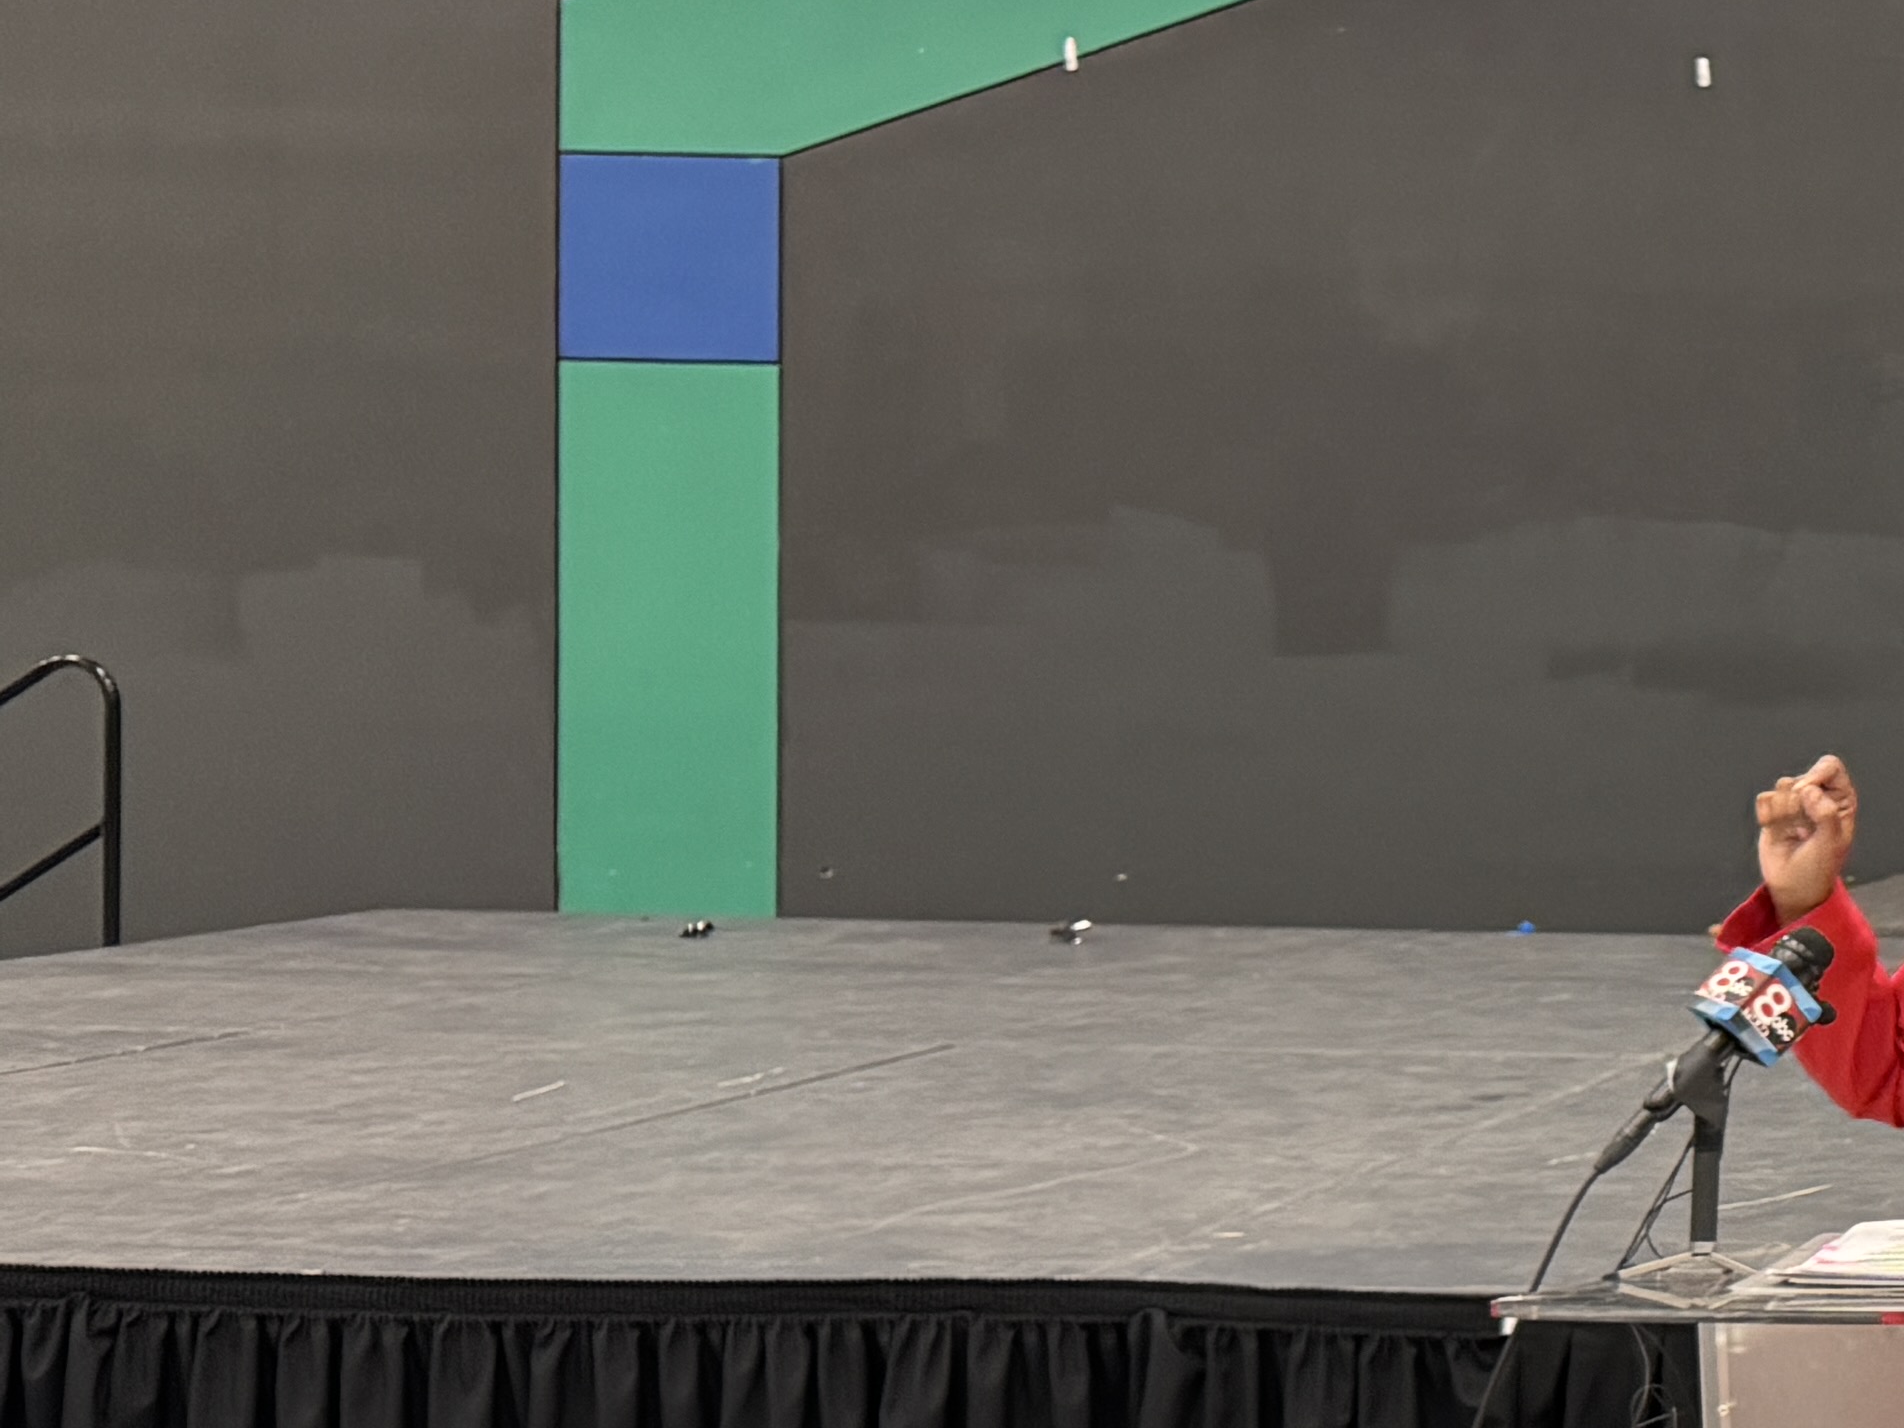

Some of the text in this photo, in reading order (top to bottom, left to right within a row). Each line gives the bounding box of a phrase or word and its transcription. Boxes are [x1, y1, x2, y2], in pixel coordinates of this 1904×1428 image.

[1708, 960, 1749, 993] 8
[1753, 983, 1792, 1025] 8
[1772, 1016, 1795, 1042] abc
